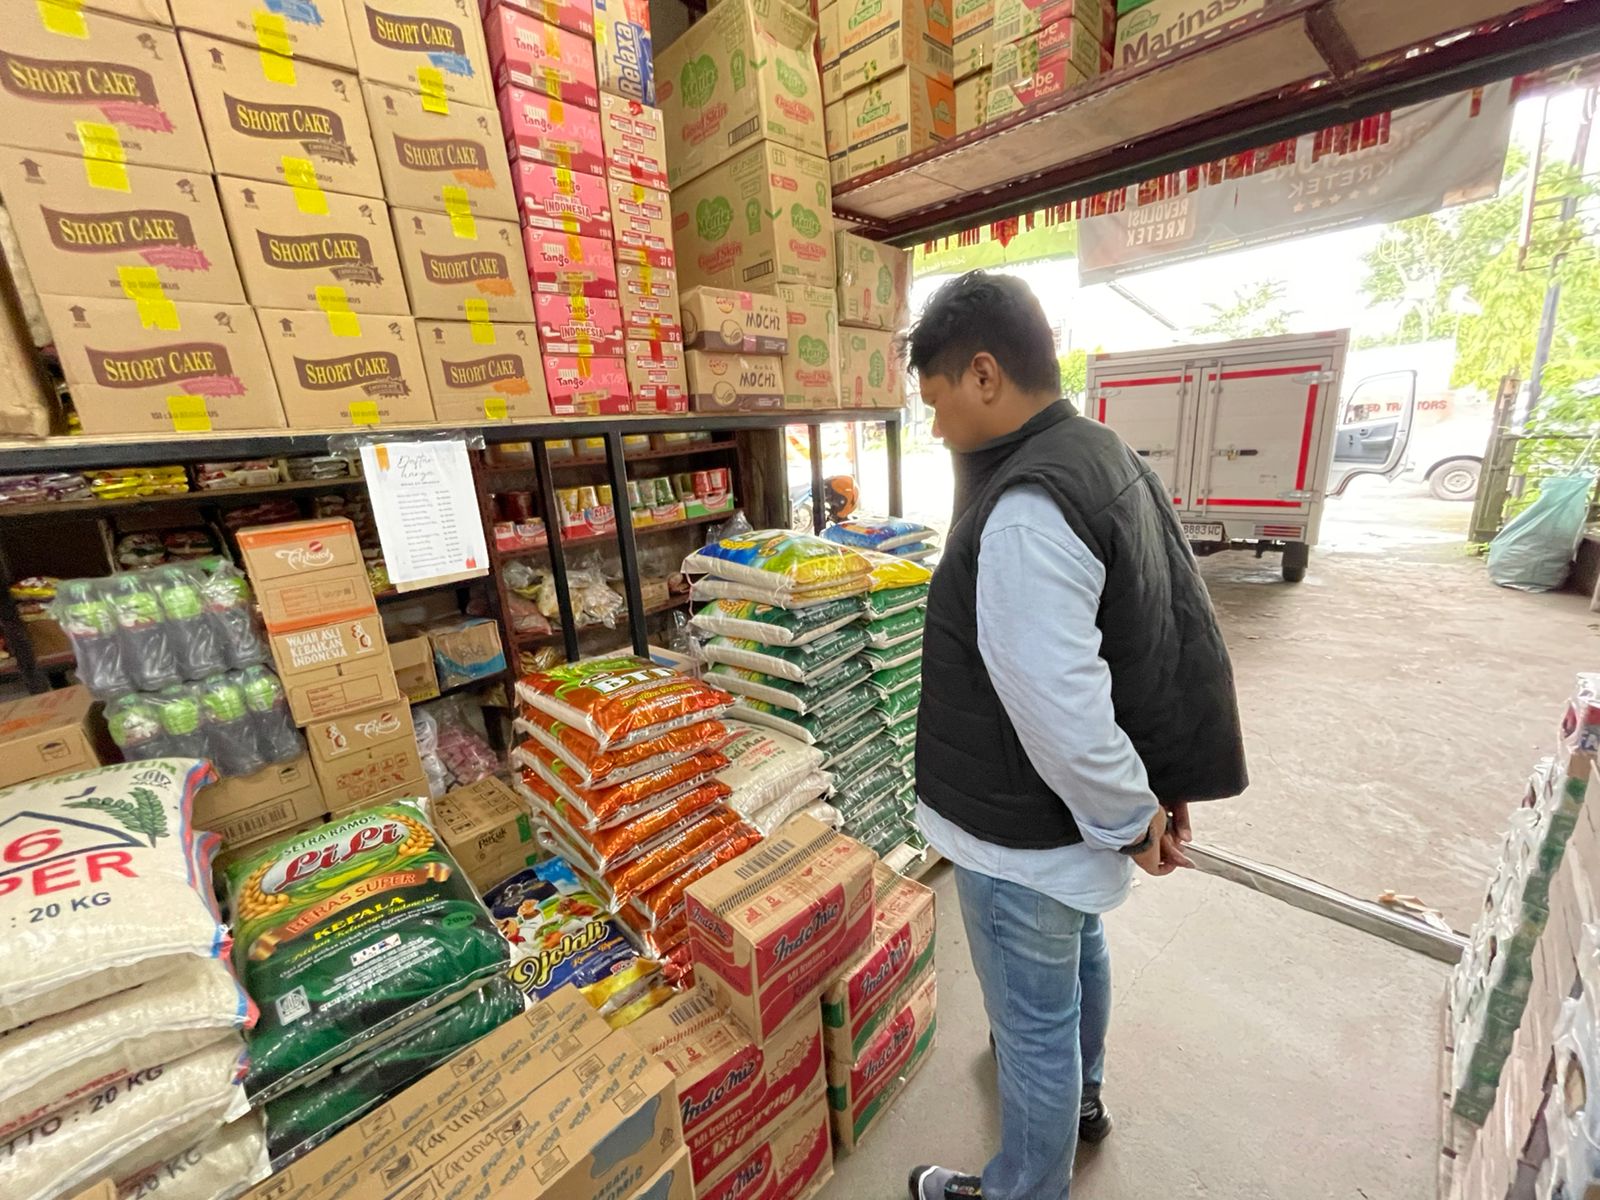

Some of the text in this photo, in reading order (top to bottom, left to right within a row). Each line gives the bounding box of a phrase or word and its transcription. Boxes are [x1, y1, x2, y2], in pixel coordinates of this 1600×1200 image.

[375, 18, 455, 48] SHORT CAKE
[514, 38, 546, 58] Tango
[613, 21, 643, 99] Relaxa
[7, 60, 138, 97] SHORT CAKE
[237, 105, 333, 135] SHORT CAKE
[521, 114, 552, 133] Tango
[403, 143, 478, 166] SHORT CAKE
[550, 177, 581, 193] Tango
[545, 200, 592, 217] INDONESIA
[59, 216, 178, 245] SHORT CAKE
[269, 237, 361, 262] SHORT CAKE
[540, 252, 569, 267] Tango
[430, 257, 498, 278] SHORT CAKE
[566, 304, 595, 318] Tango
[746, 313, 780, 331] MOCHI
[561, 326, 604, 340] INDONESIA
[103, 351, 216, 381] SHORT CAKE
[305, 358, 389, 385] SHORT CAKE
[450, 359, 516, 384] SHORT CAKE
[557, 378, 584, 390] Tango
[739, 372, 777, 388] MOCHI
[1386, 400, 1448, 412] TRATORS
[286, 627, 342, 648] WAJAH ASLI
[289, 639, 344, 657] KEBAIKAN
[292, 649, 348, 668] INDONESIA
[283, 814, 377, 856] SETRA RAMOS
[28, 892, 112, 924] 20 KG
[287, 871, 416, 934] BERAS SUPER
[312, 896, 406, 941] KEPALA
[89, 1086, 119, 1115] 20
[127, 1064, 164, 1092] KG
[680, 1060, 756, 1125] Indomie
[133, 1142, 203, 1200] 20 KG
